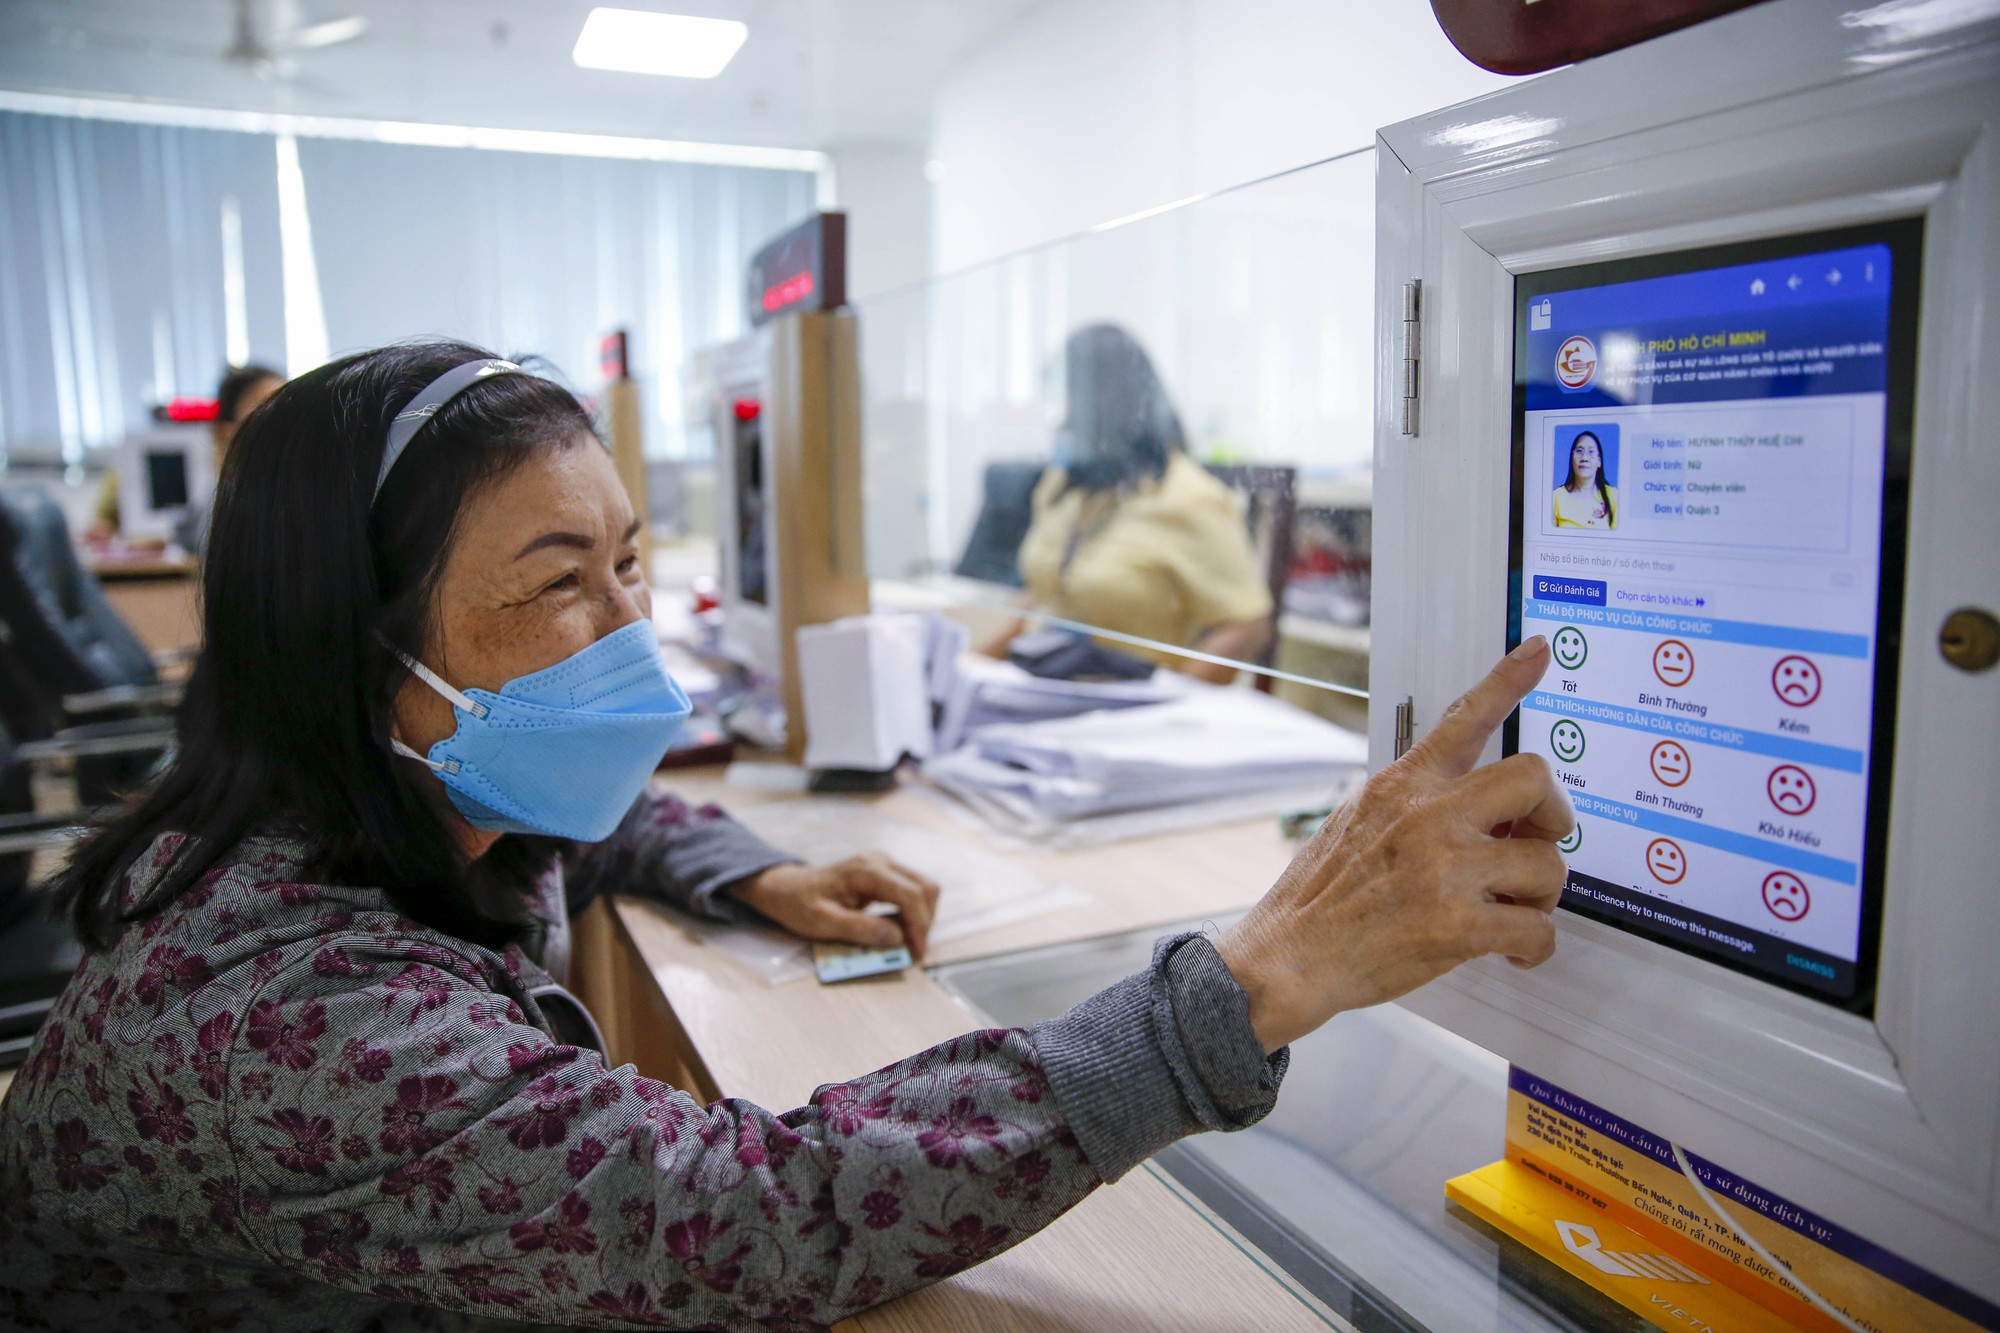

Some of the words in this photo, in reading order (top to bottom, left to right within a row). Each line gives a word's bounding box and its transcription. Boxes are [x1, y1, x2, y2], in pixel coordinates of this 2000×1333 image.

[1729, 330, 1766, 347] MINH
[1713, 505, 1720, 515] 3
[1564, 584, 1585, 596] Đánh
[1586, 586, 1600, 597] Giá
[1616, 590, 1638, 602] Chọn
[1561, 679, 1577, 693] Tốt
[1638, 693, 1662, 707] Bình
[1665, 697, 1708, 717] Thường
[1779, 717, 1810, 734] Kém
[1635, 790, 1659, 806] Bình
[1662, 796, 1703, 819] Thường
[1758, 820, 1785, 838] Khó
[1571, 882, 1592, 897] Enter
[1593, 889, 1625, 909] Licence
[1626, 900, 1642, 916] key
[1643, 907, 1653, 918] to
[1653, 912, 1687, 930] remove
[1689, 921, 1707, 937] this
[1708, 928, 1757, 954] message.
[1786, 953, 1836, 980] DISMISS
[1554, 1094, 1586, 1119] khách
[1605, 1121, 1628, 1139] nhu
[1697, 1166, 1711, 1181] và
[1735, 1184, 1769, 1211] dụng
[1773, 1202, 1804, 1227] dịch
[1810, 1225, 1834, 1241] vụ:
[1634, 1196, 1670, 1225] Chúng
[1672, 1217, 1688, 1233] tôi
[1690, 1226, 1705, 1243] rất
[1708, 1238, 1741, 1264] mong
[1677, 1203, 1701, 1223] Quận
[1714, 1222, 1730, 1239] TP.
